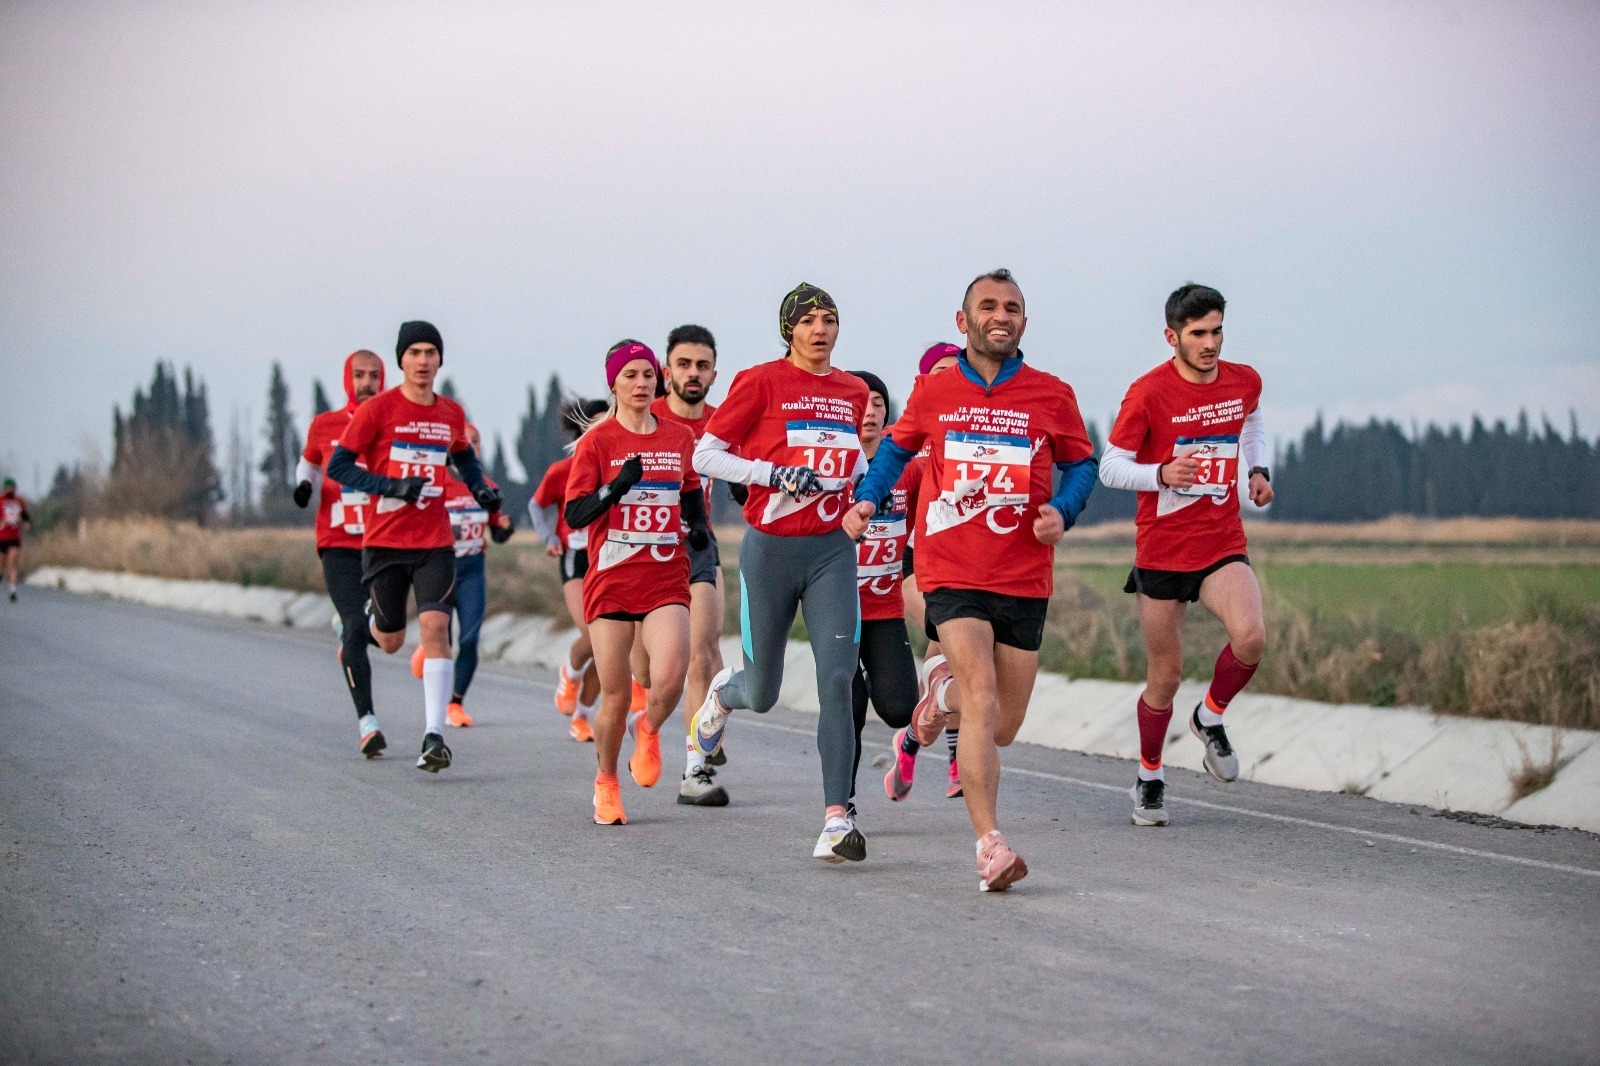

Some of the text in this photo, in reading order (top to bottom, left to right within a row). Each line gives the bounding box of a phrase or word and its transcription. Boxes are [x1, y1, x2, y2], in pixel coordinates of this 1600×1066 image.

[782, 400, 814, 410] KUBİLAY
[938, 411, 1028, 428] KUBİLAY YOL KOŞUSU
[970, 406, 990, 416] ŞEHİT
[990, 408, 1030, 420] ASTEĞMEN
[1172, 412, 1201, 424] KUBİLAY
[1211, 415, 1232, 425] ARALIK
[981, 425, 1008, 433] ARALIK
[804, 448, 848, 476] 161
[400, 463, 435, 486] 113
[956, 462, 1014, 492] 174
[620, 506, 671, 532] 189
